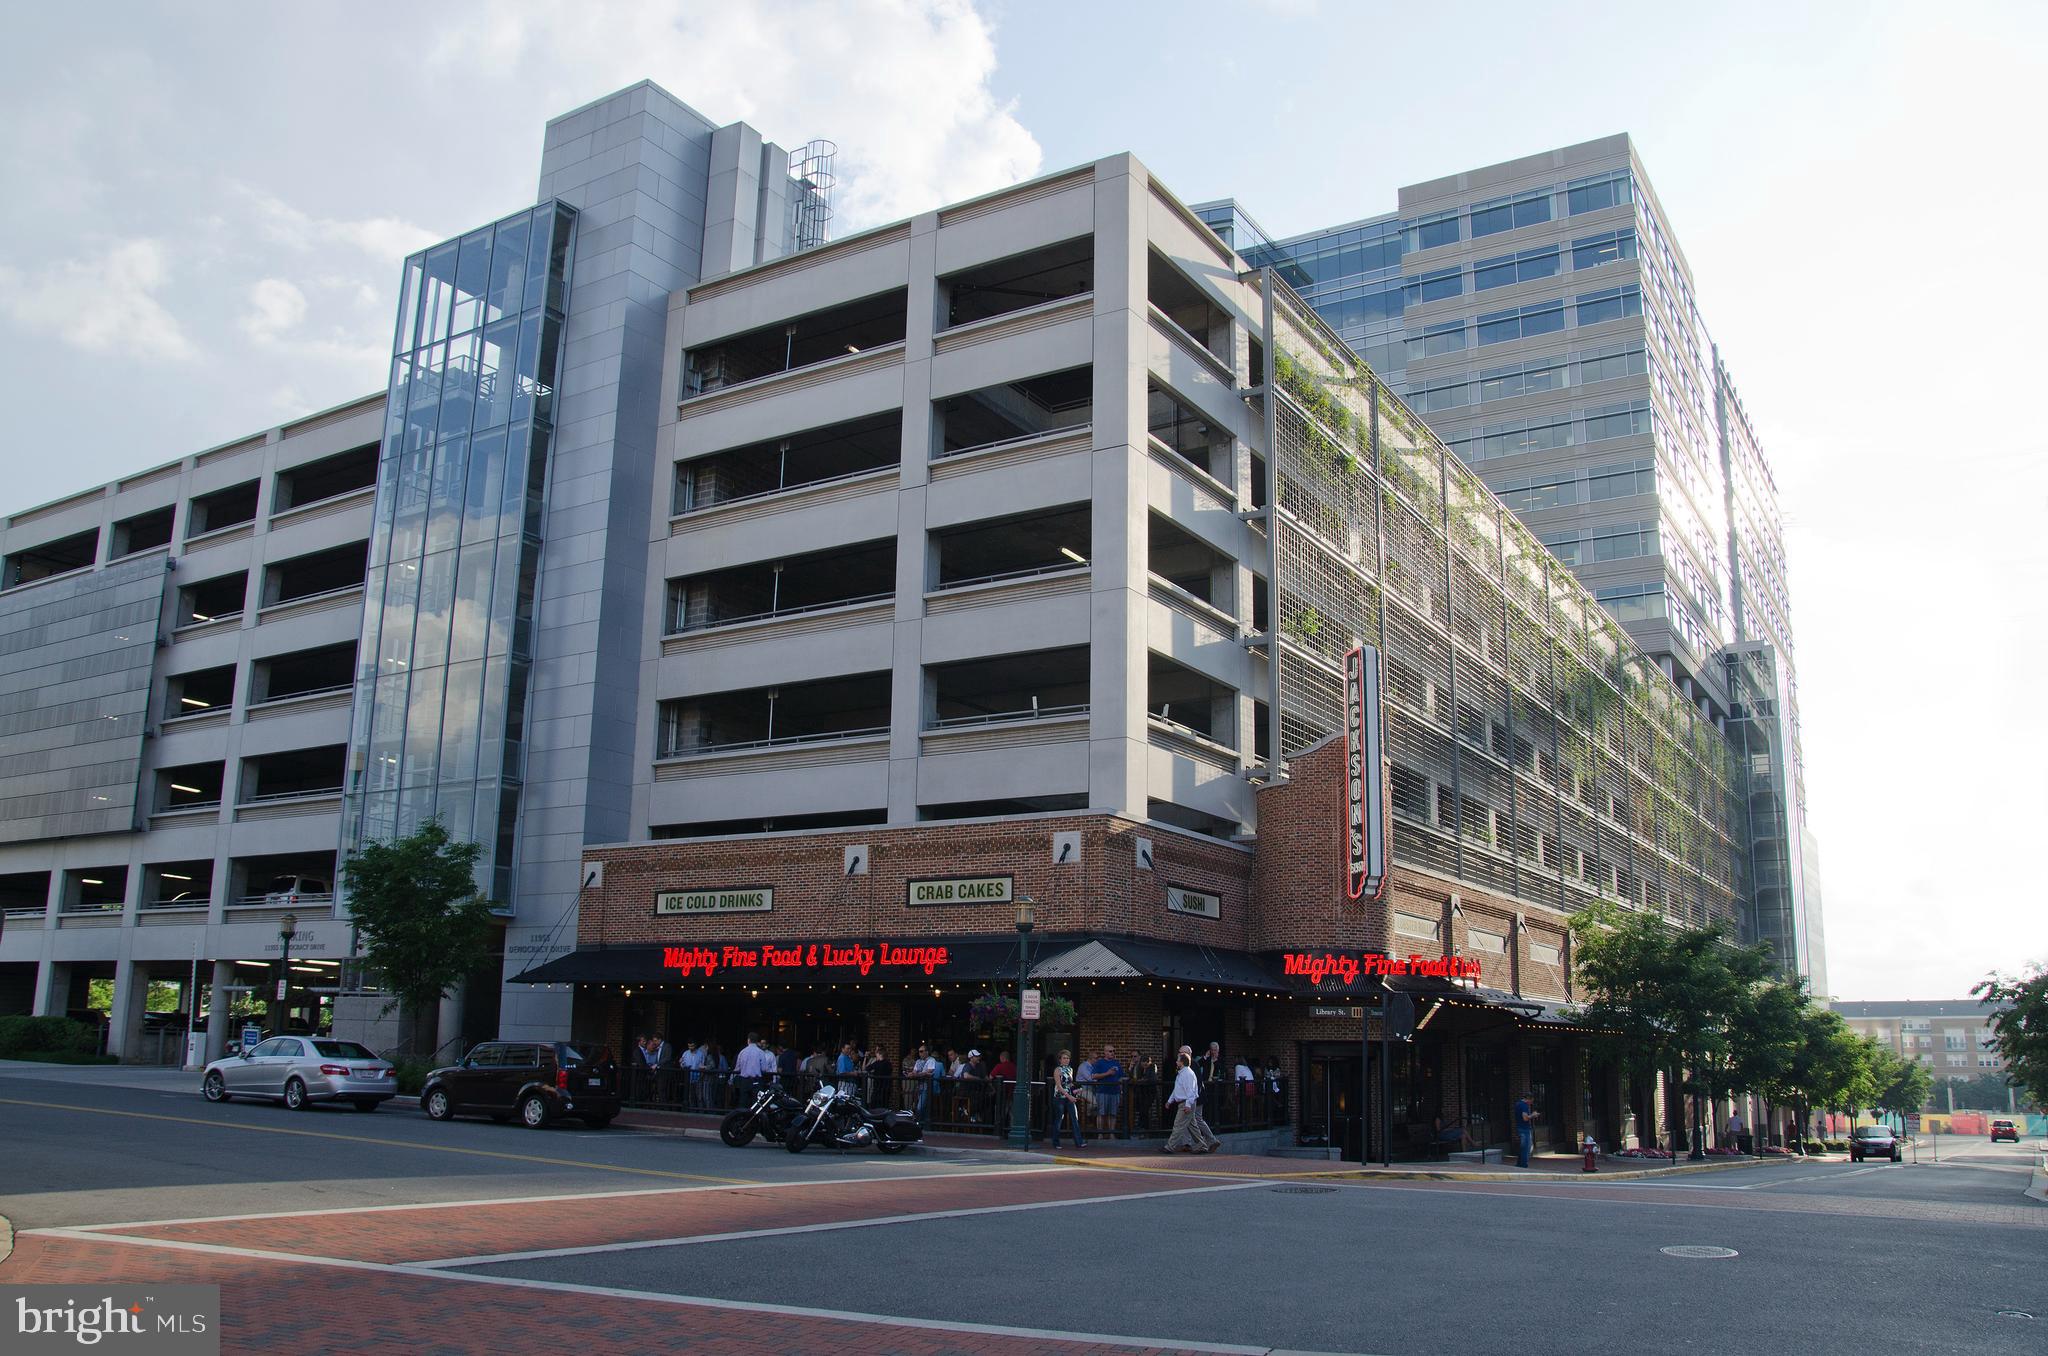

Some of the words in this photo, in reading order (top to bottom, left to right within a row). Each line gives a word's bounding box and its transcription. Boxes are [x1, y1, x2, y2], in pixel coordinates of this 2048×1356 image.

[1348, 656, 1363, 856] JACKSON'S
[917, 885, 953, 900] CRAB
[958, 882, 1004, 899] CAKES
[665, 896, 683, 910] ICE
[686, 895, 716, 909] COLD
[720, 893, 763, 908] DRINKS
[1182, 893, 1206, 912] SUSHI
[277, 930, 315, 942] PKING
[663, 947, 718, 976] Mighty
[722, 946, 758, 967] Fine
[762, 945, 802, 967] Food
[806, 944, 818, 966] &
[823, 944, 874, 976] Lucky
[880, 943, 948, 976] Lounge
[1283, 953, 1360, 985] Mighty
[1364, 953, 1407, 976] Fine
[1409, 954, 1449, 977] Food
[1449, 955, 1458, 977] &
[1315, 1008, 1336, 1016] Library
